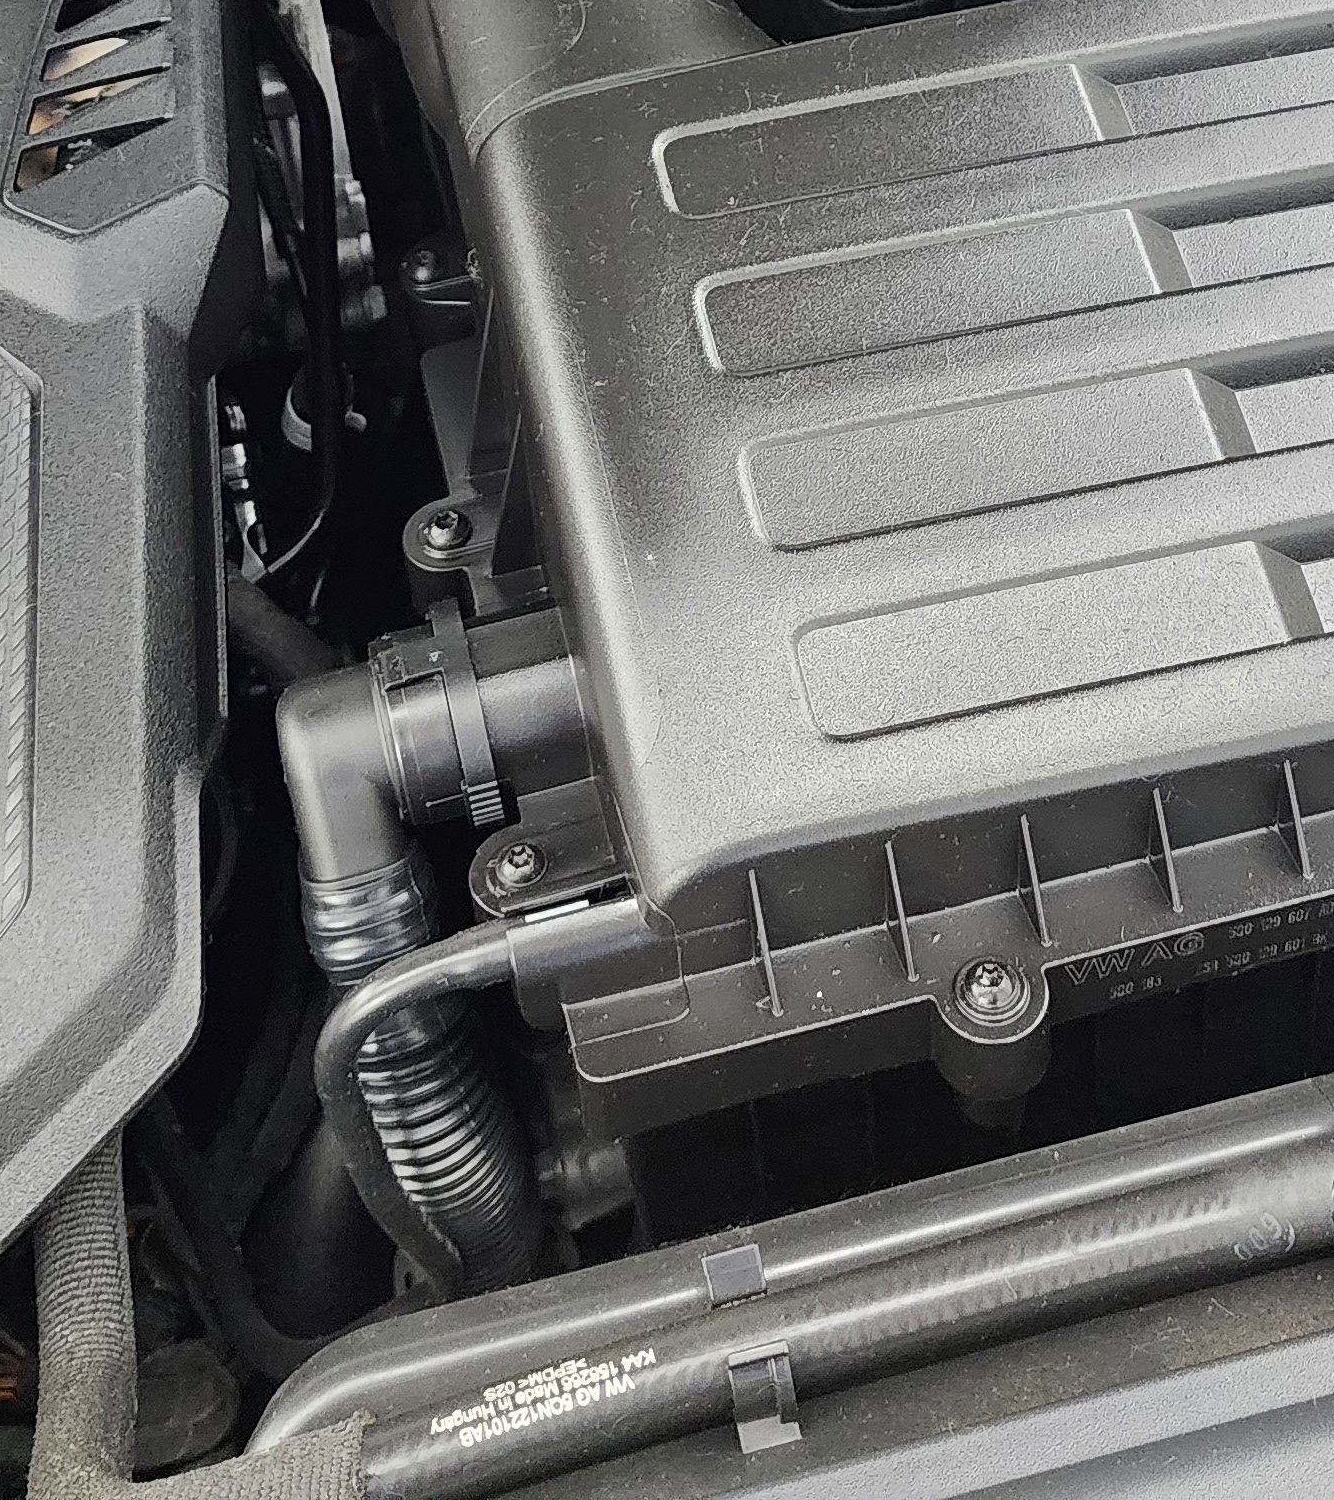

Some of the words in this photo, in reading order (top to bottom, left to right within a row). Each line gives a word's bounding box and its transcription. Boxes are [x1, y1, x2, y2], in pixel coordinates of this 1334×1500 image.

[1065, 948, 1136, 985] VW
[1141, 931, 1205, 968] AG
[621, 1347, 657, 1372] KA4
[518, 1357, 588, 1389] >EPDM<
[604, 1373, 636, 1398] VW
[482, 1380, 516, 1402] 02S
[515, 1379, 560, 1405] Made
[575, 1386, 601, 1407] AG
